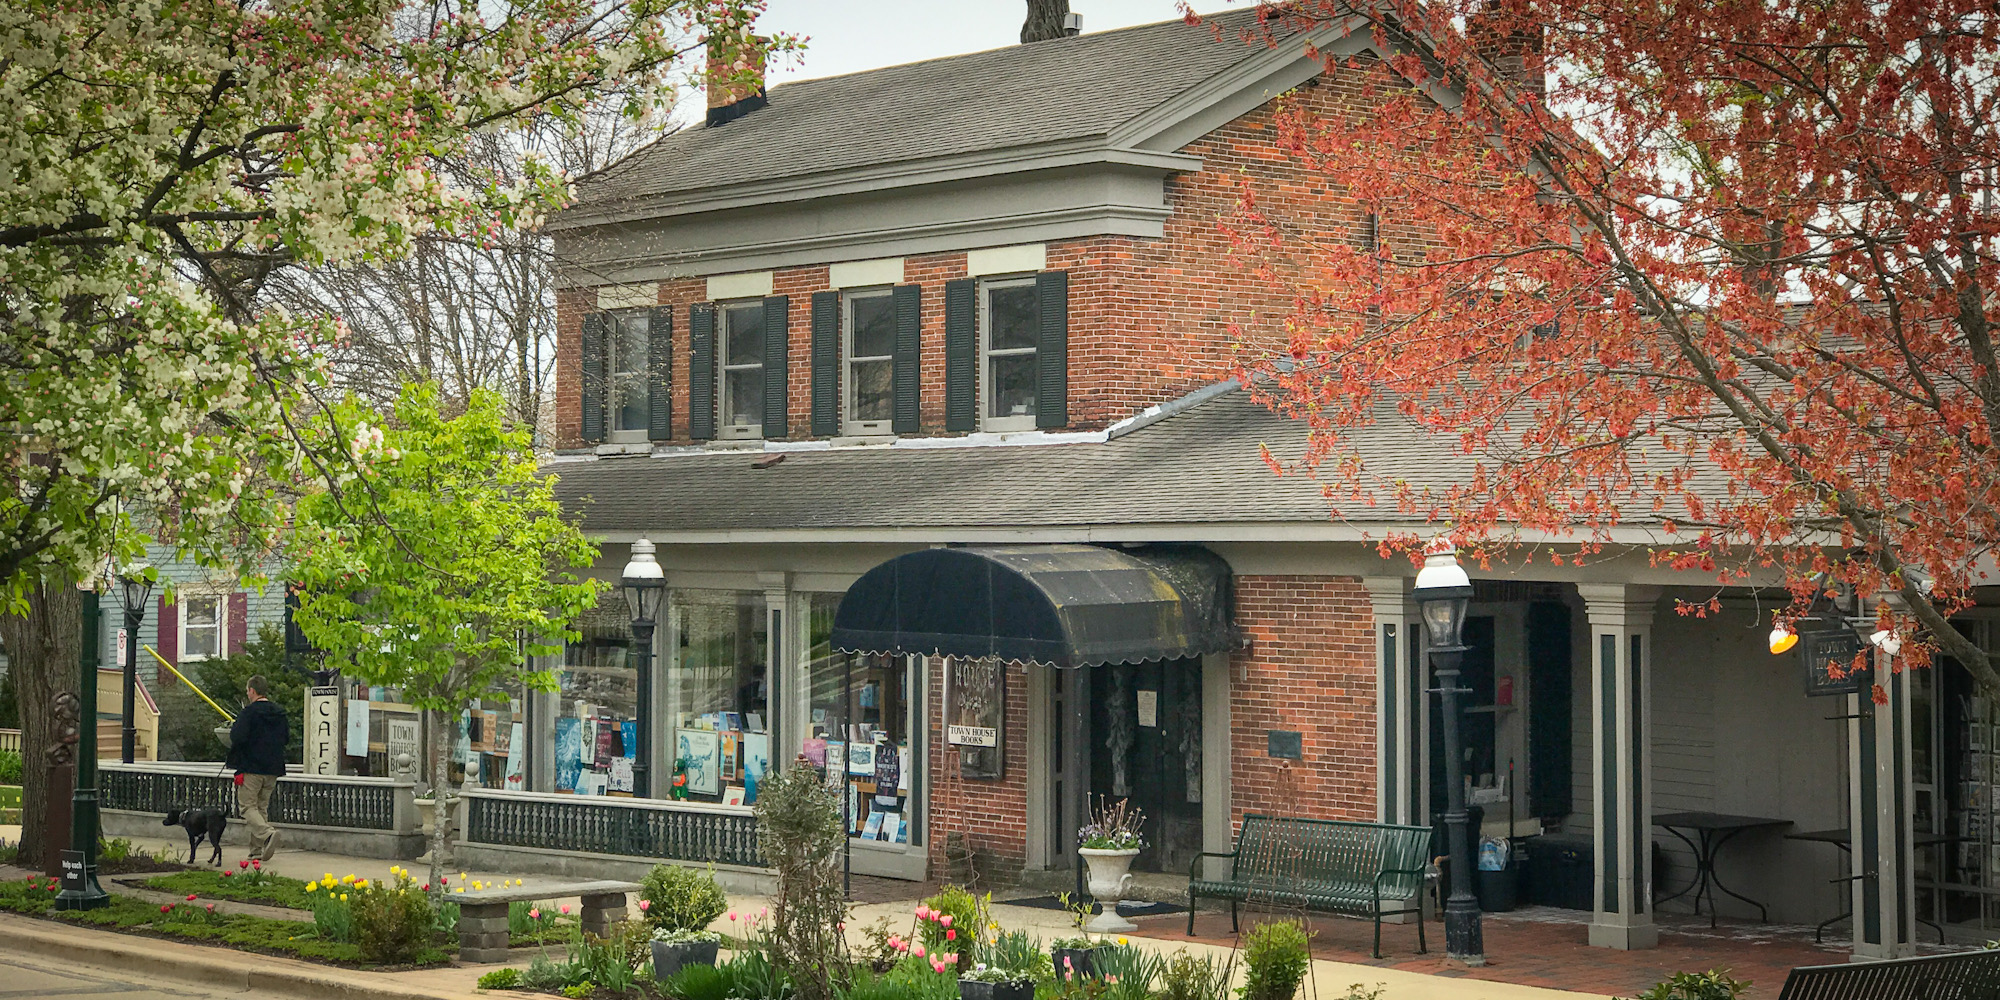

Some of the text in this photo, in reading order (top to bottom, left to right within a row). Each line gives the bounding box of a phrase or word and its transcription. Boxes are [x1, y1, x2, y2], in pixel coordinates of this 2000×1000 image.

[1818, 641, 1848, 654] TOWN
[1816, 656, 1850, 670] HSE
[955, 663, 995, 689] HOUSE
[318, 700, 331, 775] CAFE
[392, 725, 414, 741] TOWN
[950, 726, 996, 737] TOWN HOUSE
[960, 735, 983, 744] BOOKS
[390, 741, 417, 757] HOUSE
[390, 758, 417, 774] BOS
[62, 860, 83, 870] Help each
[66, 872, 78, 880] other
